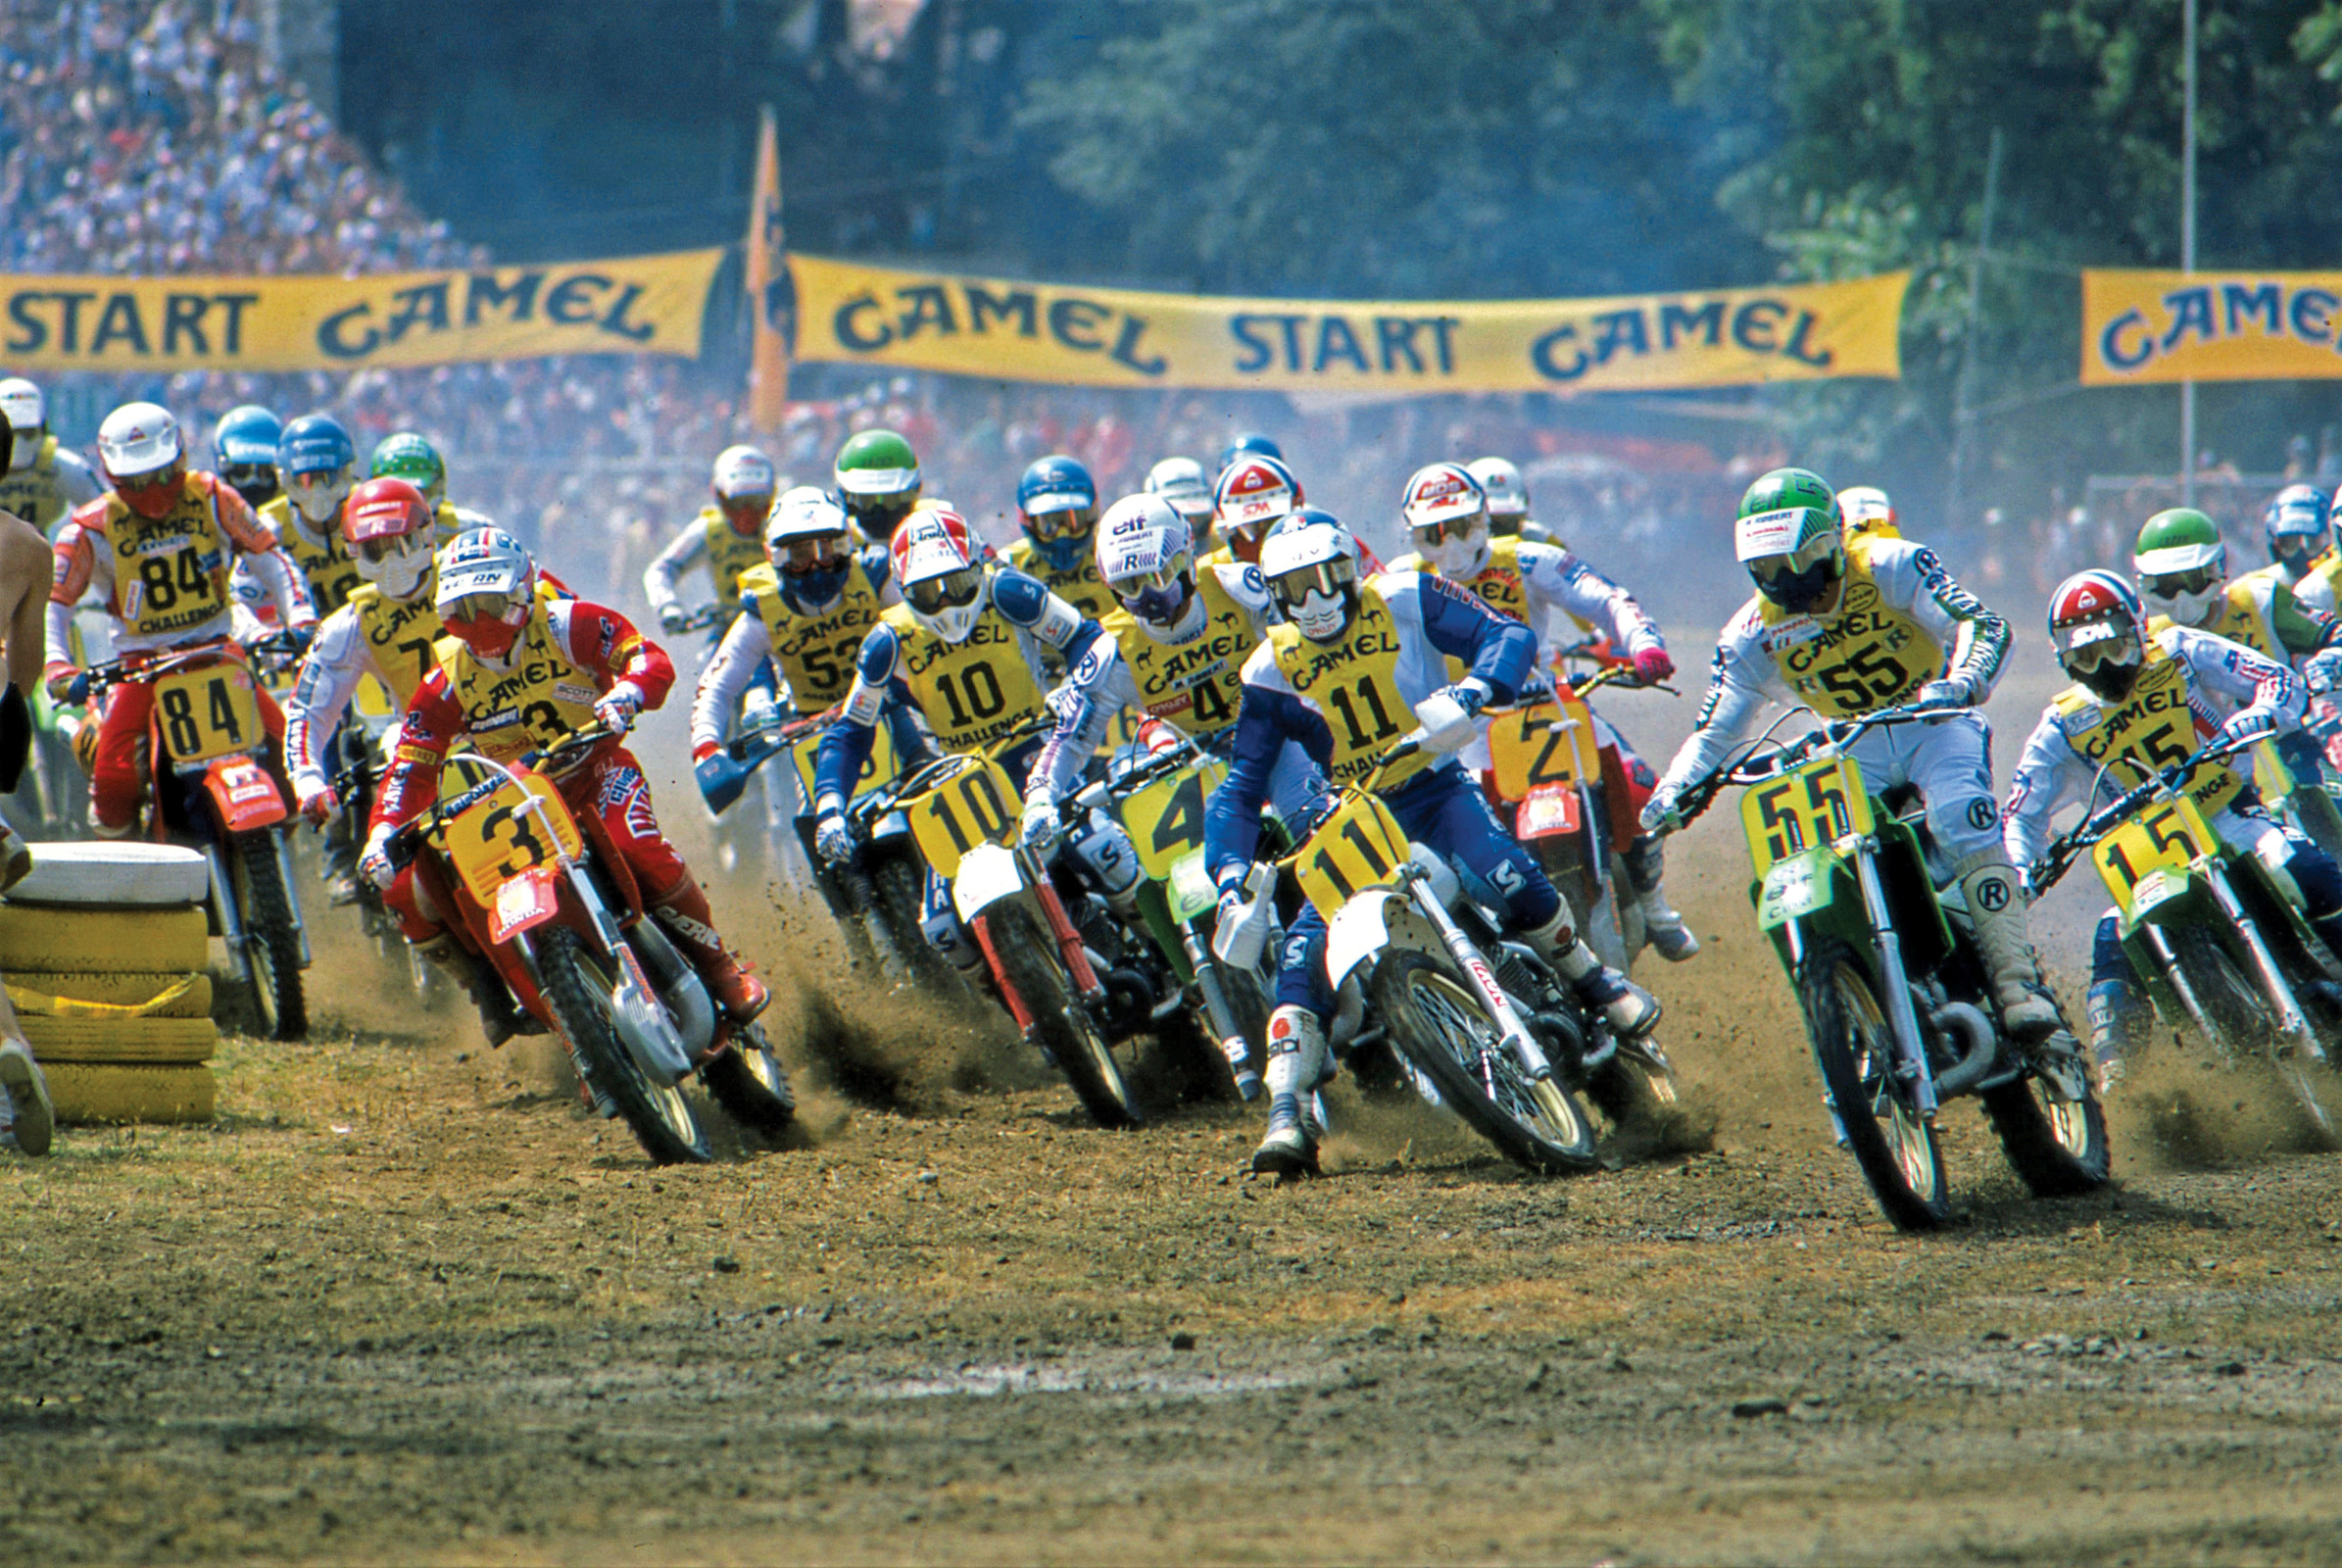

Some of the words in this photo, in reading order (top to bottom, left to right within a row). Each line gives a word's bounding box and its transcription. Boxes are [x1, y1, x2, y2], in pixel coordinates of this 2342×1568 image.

[5, 291, 259, 356] START
[316, 272, 657, 360] CAMEL
[833, 284, 1167, 376] CAMEL
[1230, 314, 1461, 374] START
[1531, 299, 1835, 383] CAMEL
[118, 516, 211, 558] CAMEL
[139, 545, 210, 612] 84
[371, 596, 433, 646] CAM
[779, 610, 878, 657] CAMEL
[907, 624, 1009, 676] CAMEL
[1787, 612, 1894, 673] CAMEL
[468, 659, 572, 722] CAMEL
[558, 684, 595, 699] SCOTT
[936, 661, 1006, 728] 10
[1145, 633, 1251, 696] CAMEL
[1291, 632, 1400, 693] CAMEL
[1818, 641, 1909, 710] 55
[161, 677, 242, 757] 84
[521, 700, 571, 751] 3
[1193, 677, 1232, 722] 4
[1330, 658, 1400, 752] 11
[2085, 688, 2188, 760] CAMEL
[1520, 718, 1571, 785] 2
[2122, 721, 2198, 785] 15
[481, 806, 546, 879] 3
[929, 769, 1010, 858] 10
[1151, 771, 1206, 855] 4
[1757, 763, 1850, 860] 55
[1974, 801, 1993, 824] R
[1315, 816, 1392, 902] 11
[2107, 808, 2197, 888] 15
[1984, 884, 2004, 906] R
